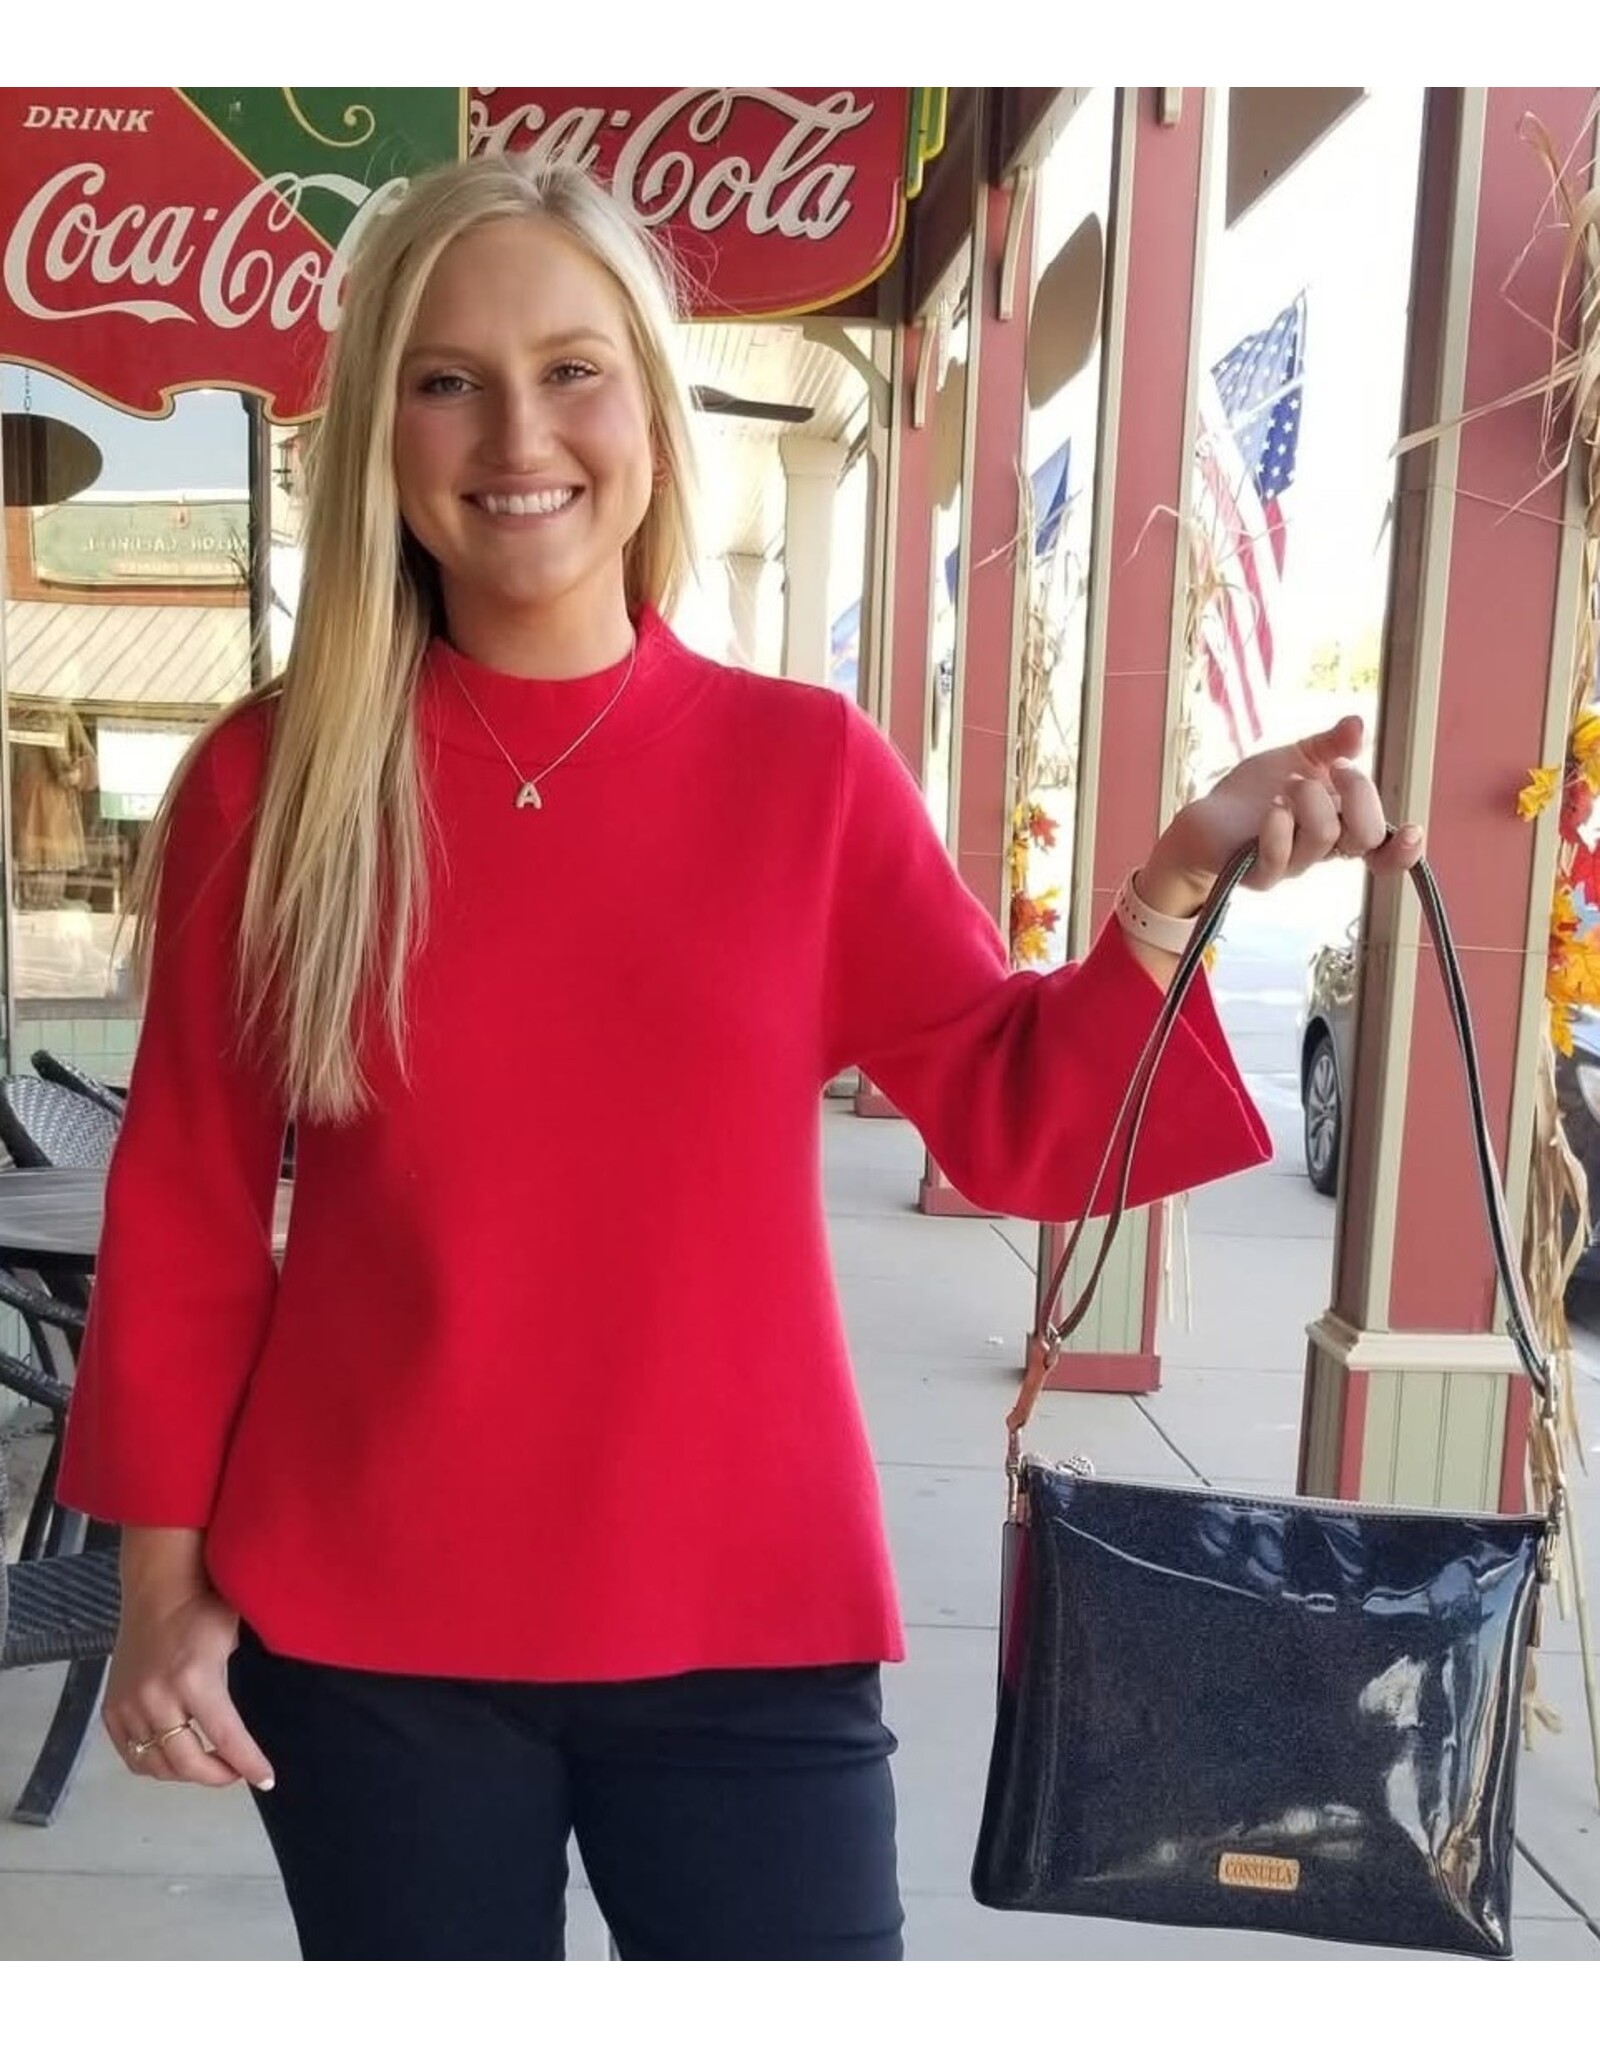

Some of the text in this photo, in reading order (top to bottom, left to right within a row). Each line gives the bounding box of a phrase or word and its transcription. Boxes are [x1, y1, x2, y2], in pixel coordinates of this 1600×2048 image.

[23, 105, 153, 133] DRINK
[4, 161, 410, 333] Coca-Col
[516, 781, 542, 809] A
